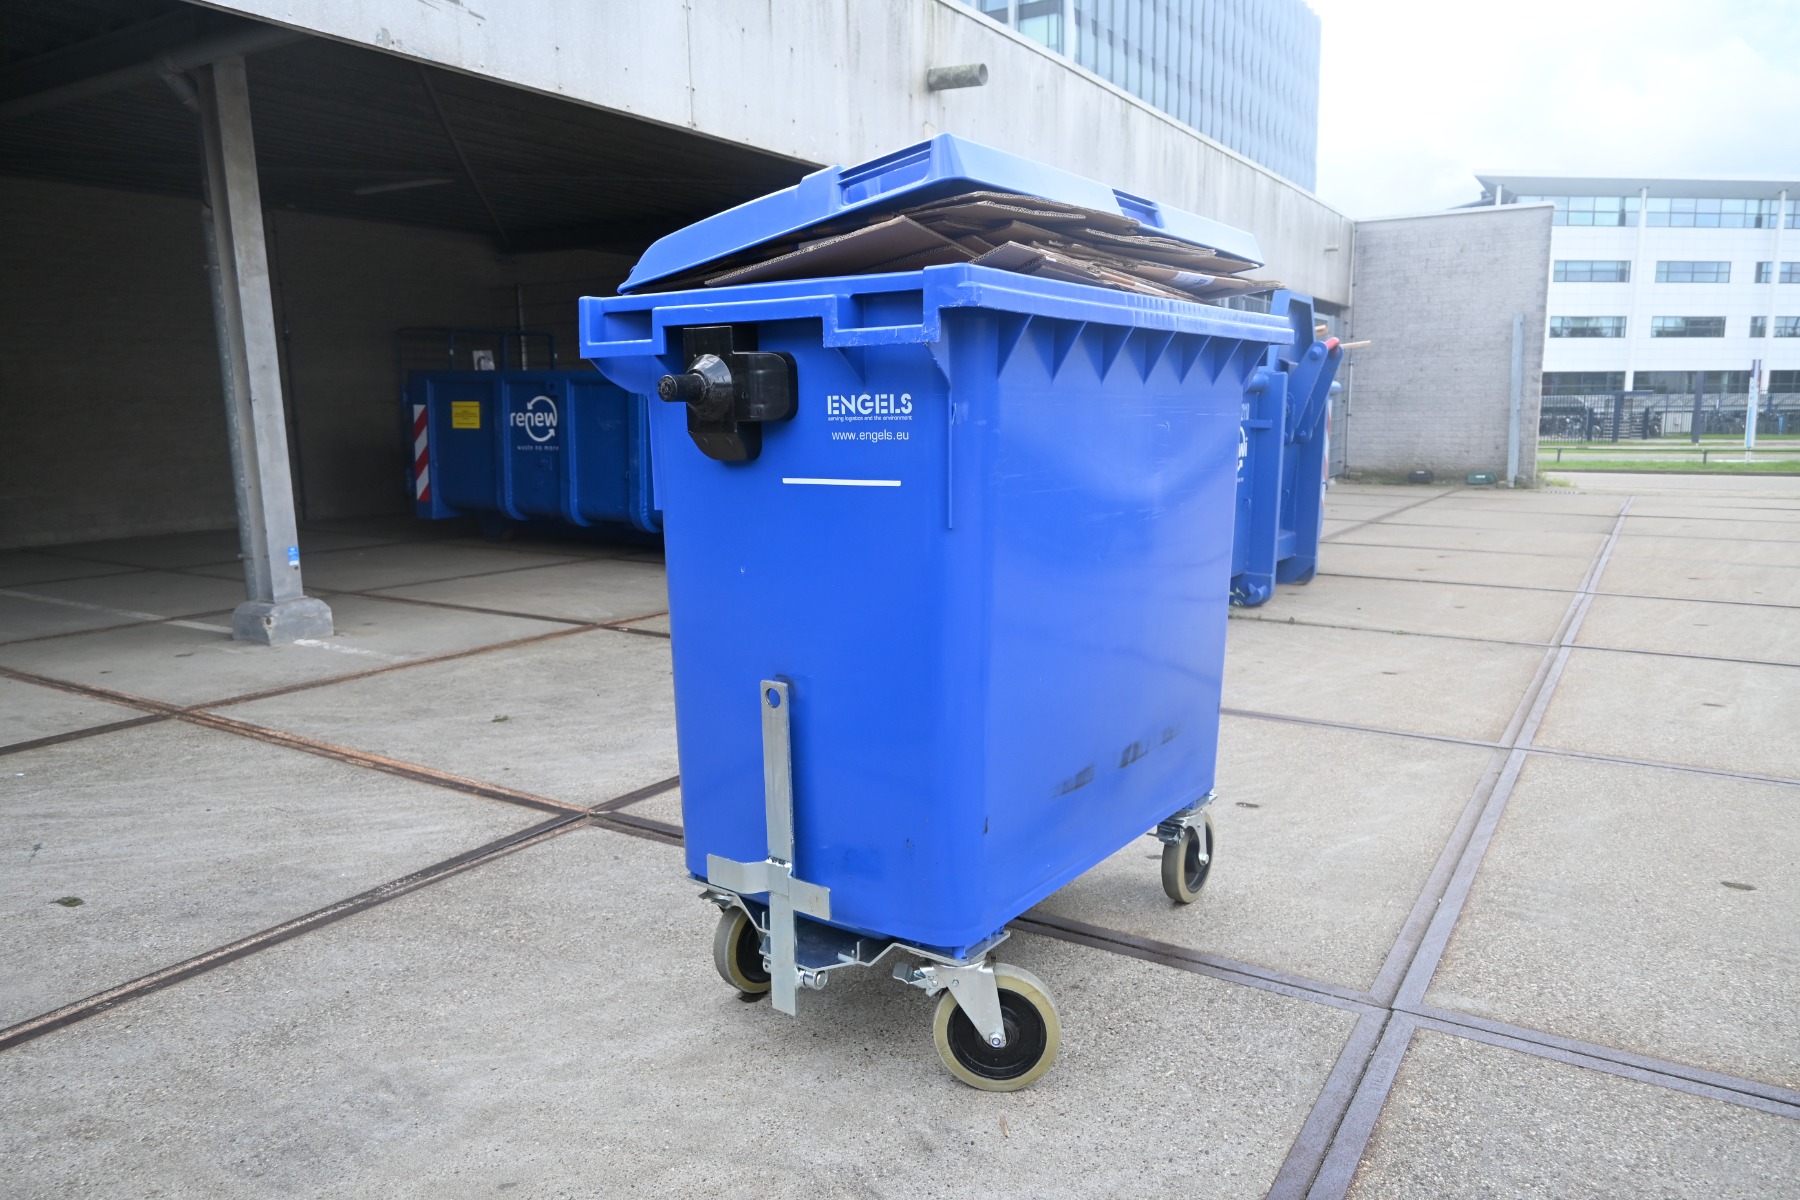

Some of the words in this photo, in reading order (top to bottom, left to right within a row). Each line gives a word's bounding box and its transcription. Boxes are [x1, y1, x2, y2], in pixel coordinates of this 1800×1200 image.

[827, 393, 913, 415] ENGELS
[510, 412, 558, 427] renew
[831, 429, 910, 443] www.engels.eu
